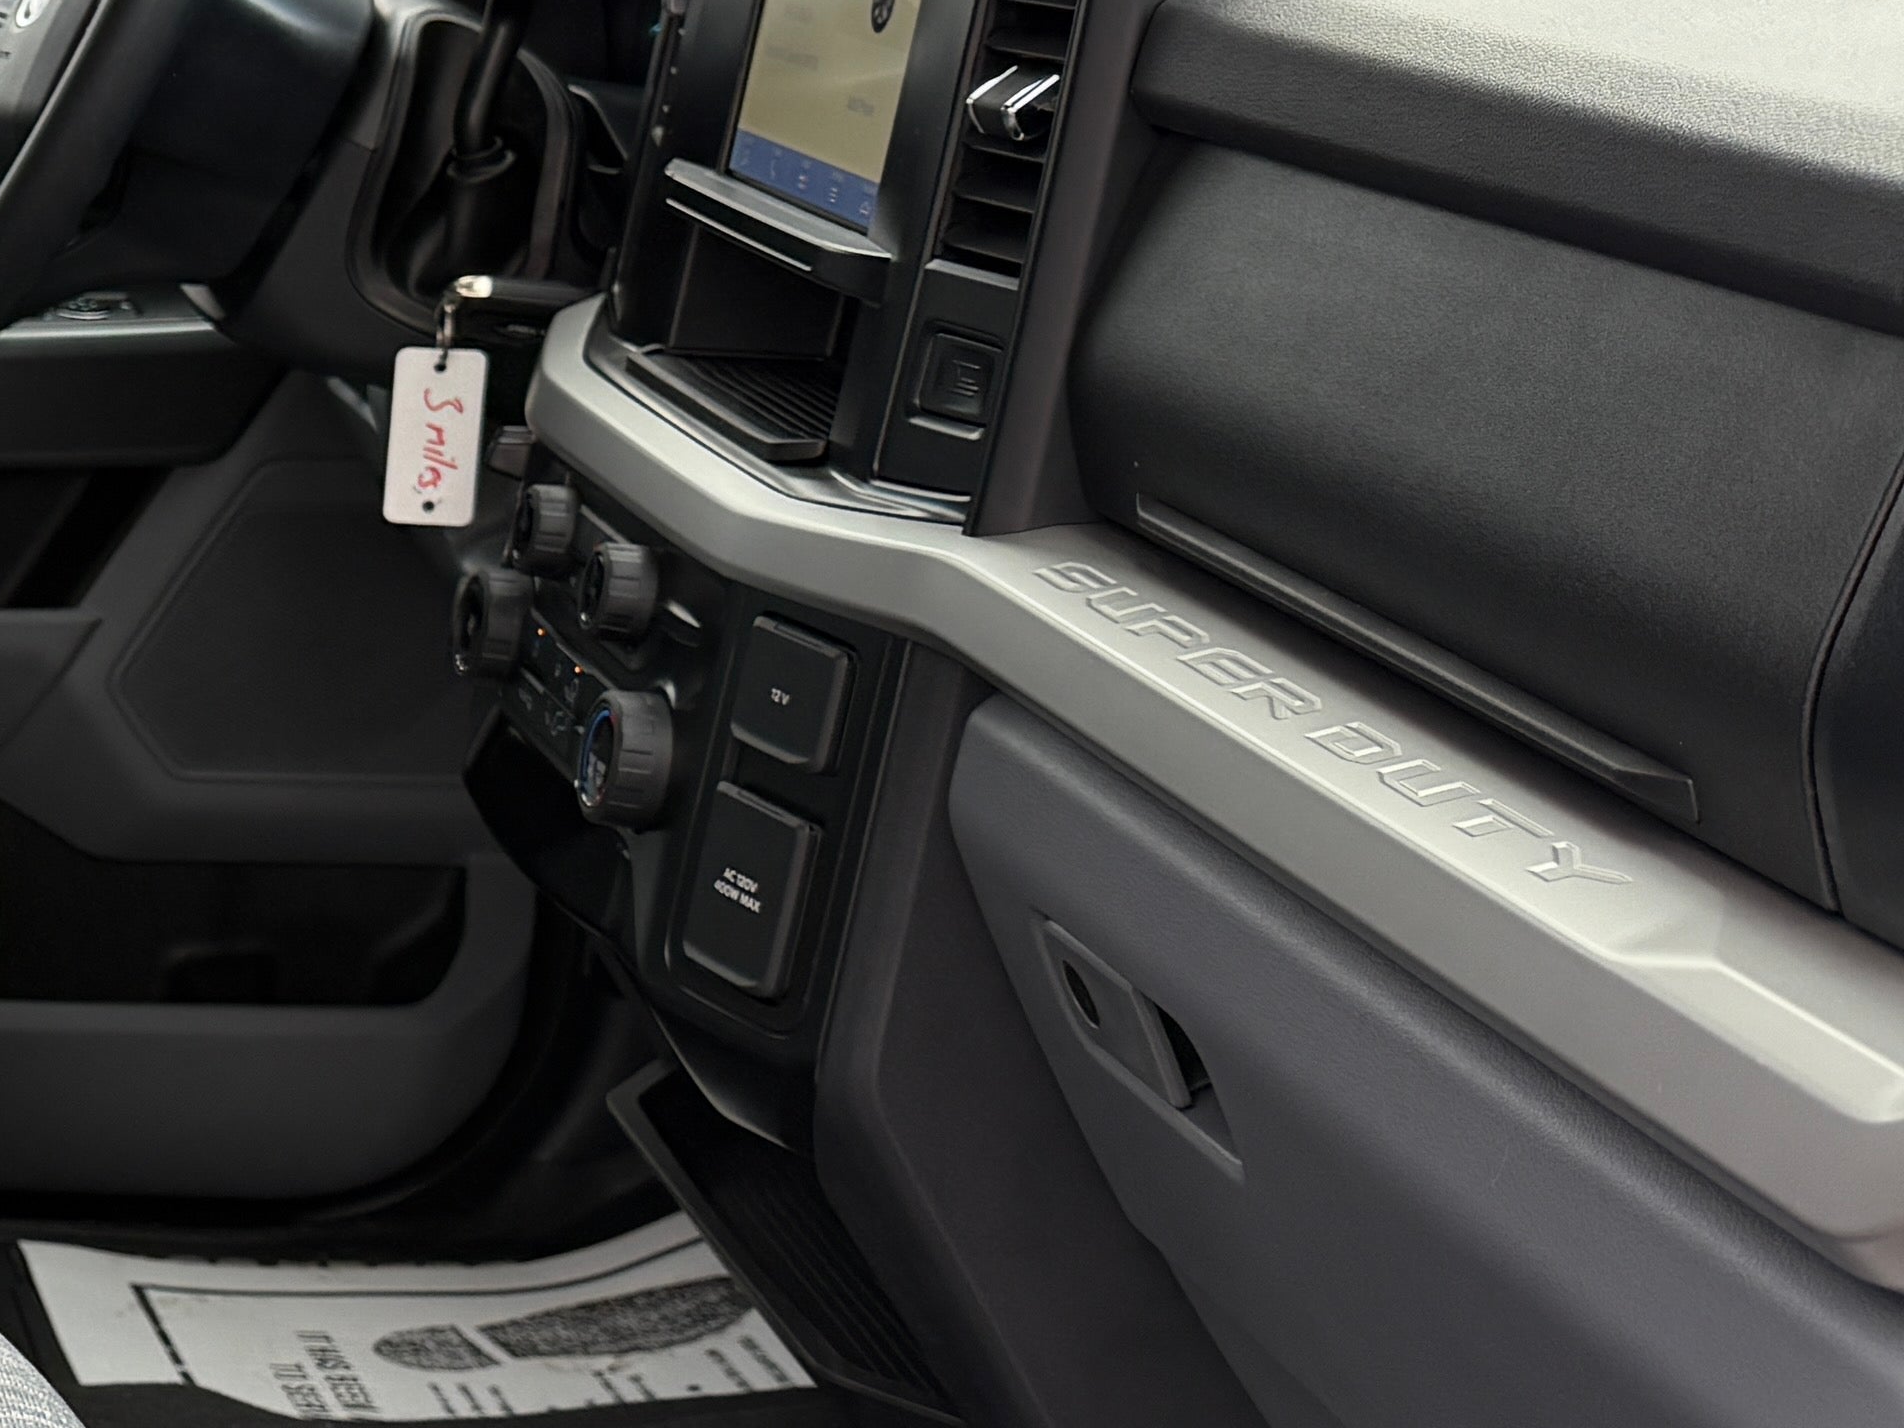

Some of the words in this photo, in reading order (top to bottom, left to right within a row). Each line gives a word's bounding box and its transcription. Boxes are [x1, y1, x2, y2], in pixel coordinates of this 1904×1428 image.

[1032, 560, 1323, 721] SUPER
[1302, 720, 1635, 886] DUTY
[740, 892, 762, 913] MAX
